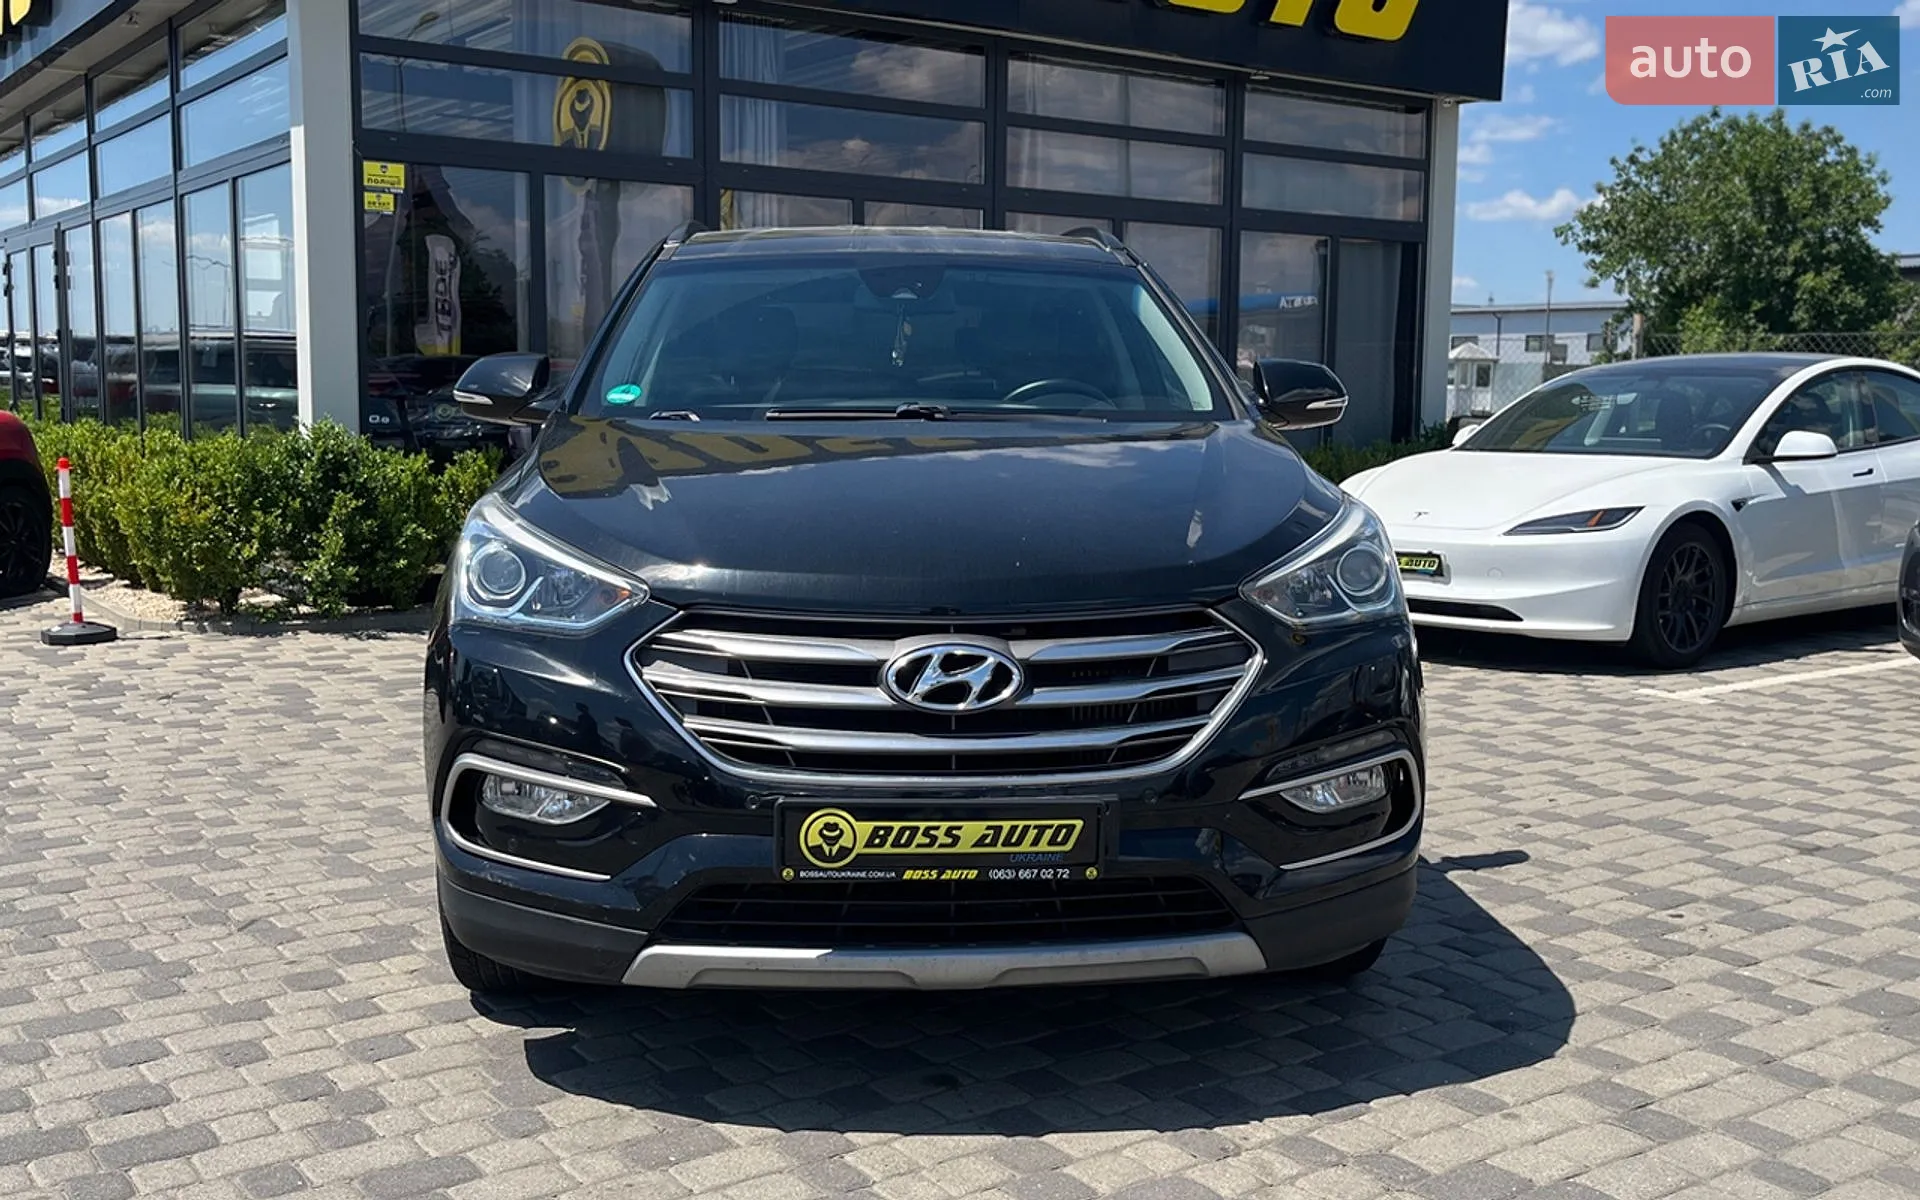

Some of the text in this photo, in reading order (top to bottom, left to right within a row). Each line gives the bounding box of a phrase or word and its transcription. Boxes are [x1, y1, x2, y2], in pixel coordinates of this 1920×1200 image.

[863, 823, 1077, 849] BOSS AUTO
[1009, 852, 1064, 863] UKRAINE
[799, 868, 1070, 880] BOSSAUTOUKRAINE.COM.UA BOSS AUTO (063) 667 02 72
